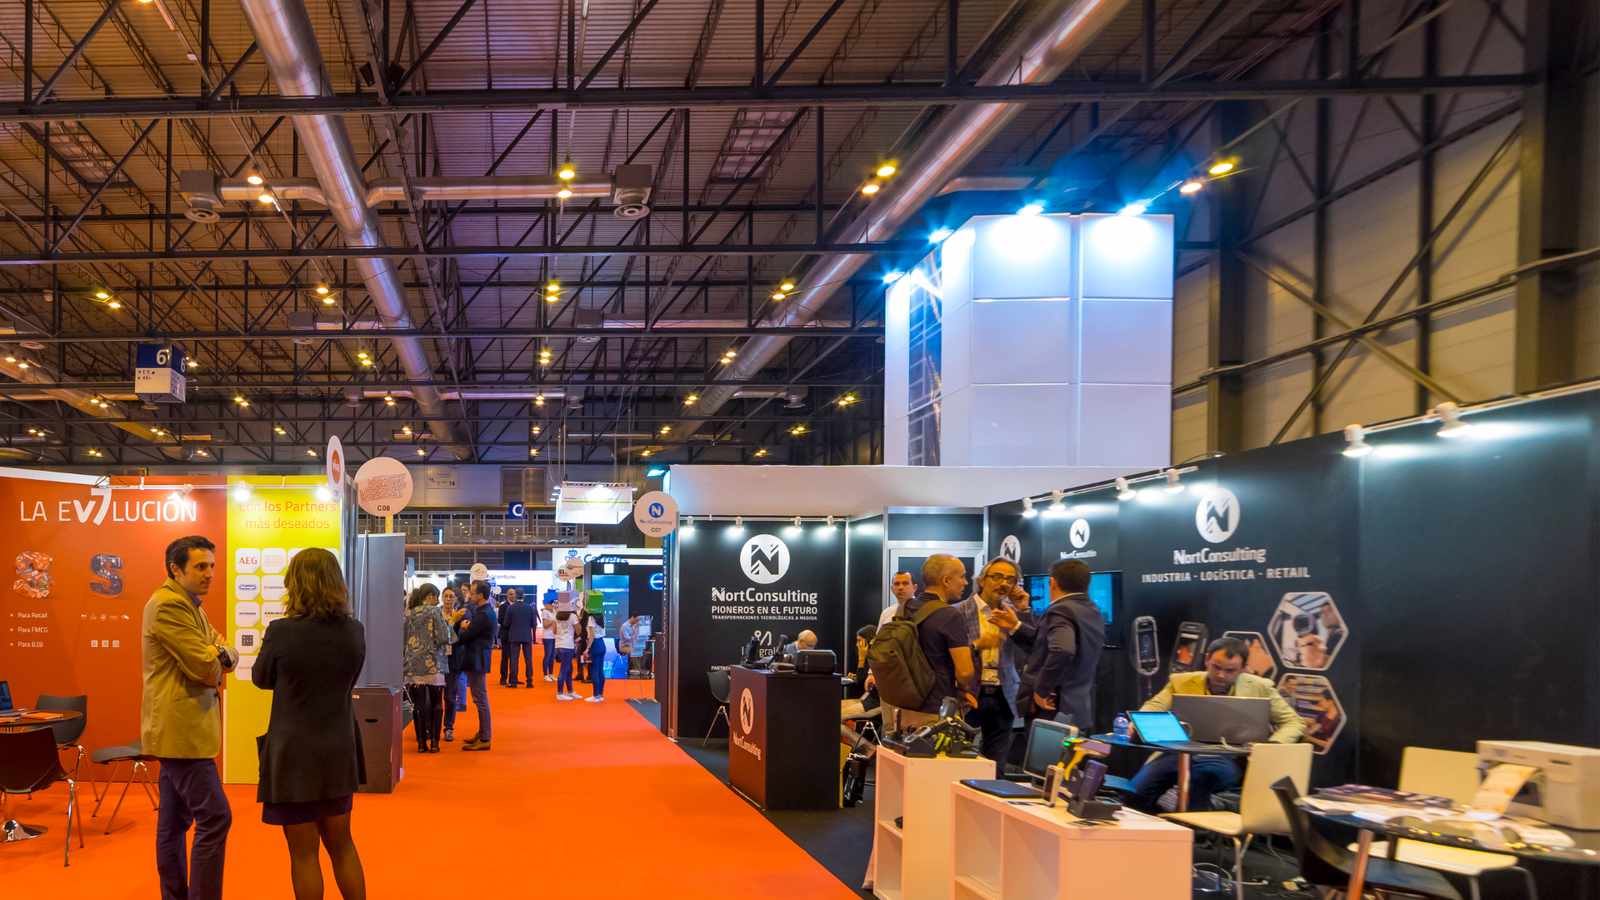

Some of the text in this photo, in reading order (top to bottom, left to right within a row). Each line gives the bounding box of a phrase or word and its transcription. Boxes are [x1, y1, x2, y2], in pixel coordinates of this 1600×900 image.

[156, 349, 167, 366] 6
[21, 501, 47, 522] LA
[264, 501, 282, 511] los
[285, 501, 337, 511] Partners
[512, 504, 522, 517] C
[245, 517, 330, 529] más deseados
[238, 556, 258, 565] AEG
[1173, 547, 1267, 565] NortConsulting
[1142, 572, 1192, 583] INDUSTRIA
[1200, 569, 1255, 581] LOGÍSTICA
[1266, 567, 1311, 579] RETAIL
[711, 587, 818, 605] NortConsulting
[711, 606, 818, 614] PIONEROS EN EL FUTURO
[741, 646, 776, 659] Igral
